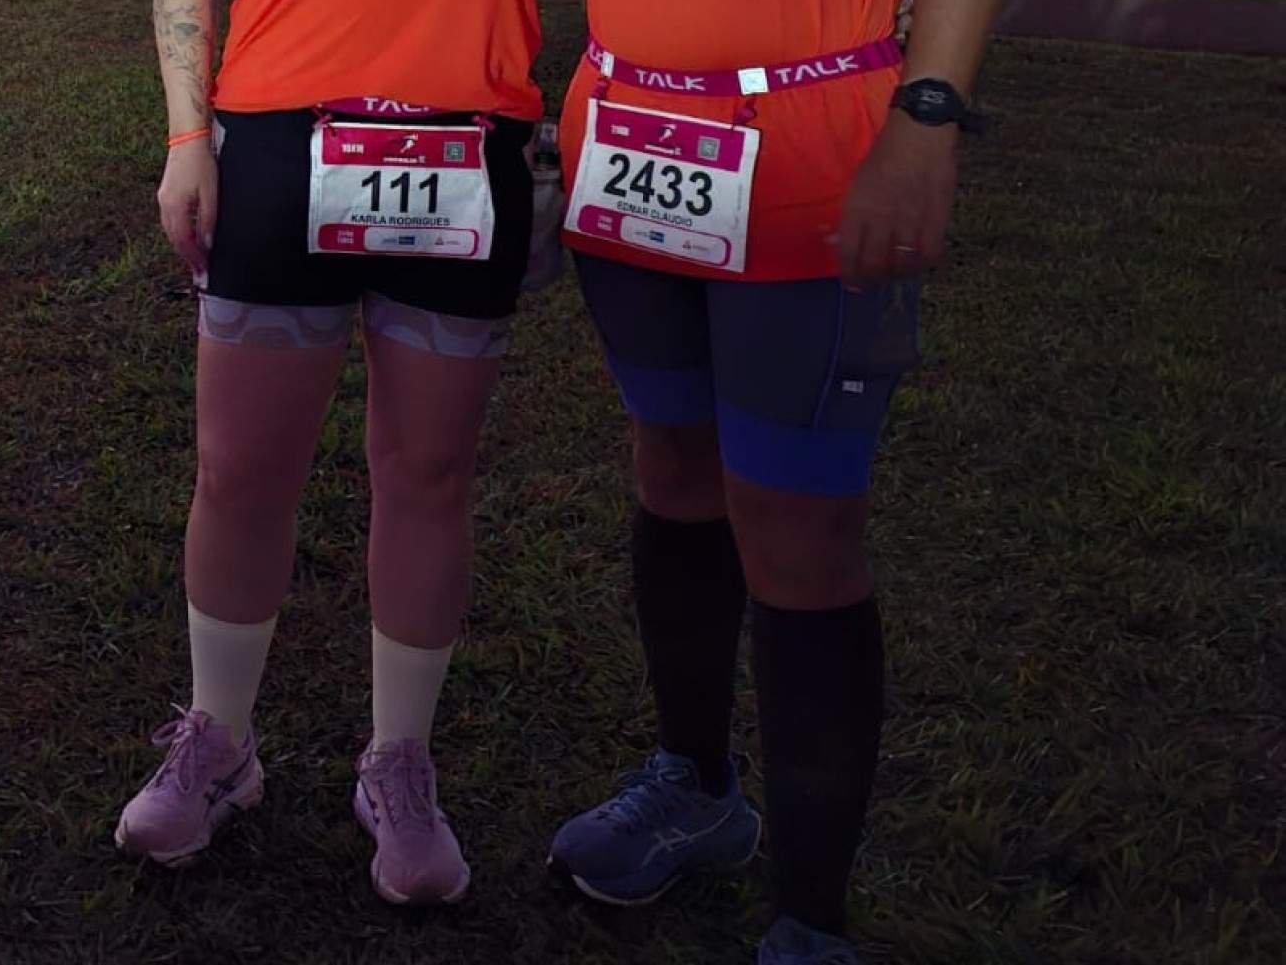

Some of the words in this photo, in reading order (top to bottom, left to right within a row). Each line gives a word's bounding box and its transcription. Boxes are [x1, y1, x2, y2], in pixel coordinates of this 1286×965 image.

[635, 69, 706, 91] TALK
[775, 54, 859, 84] TALK
[364, 97, 430, 113] TAL
[361, 170, 440, 214] 111
[603, 152, 713, 217] 2433
[351, 215, 386, 225] KARLA
[389, 216, 451, 226] RODRIGUES
